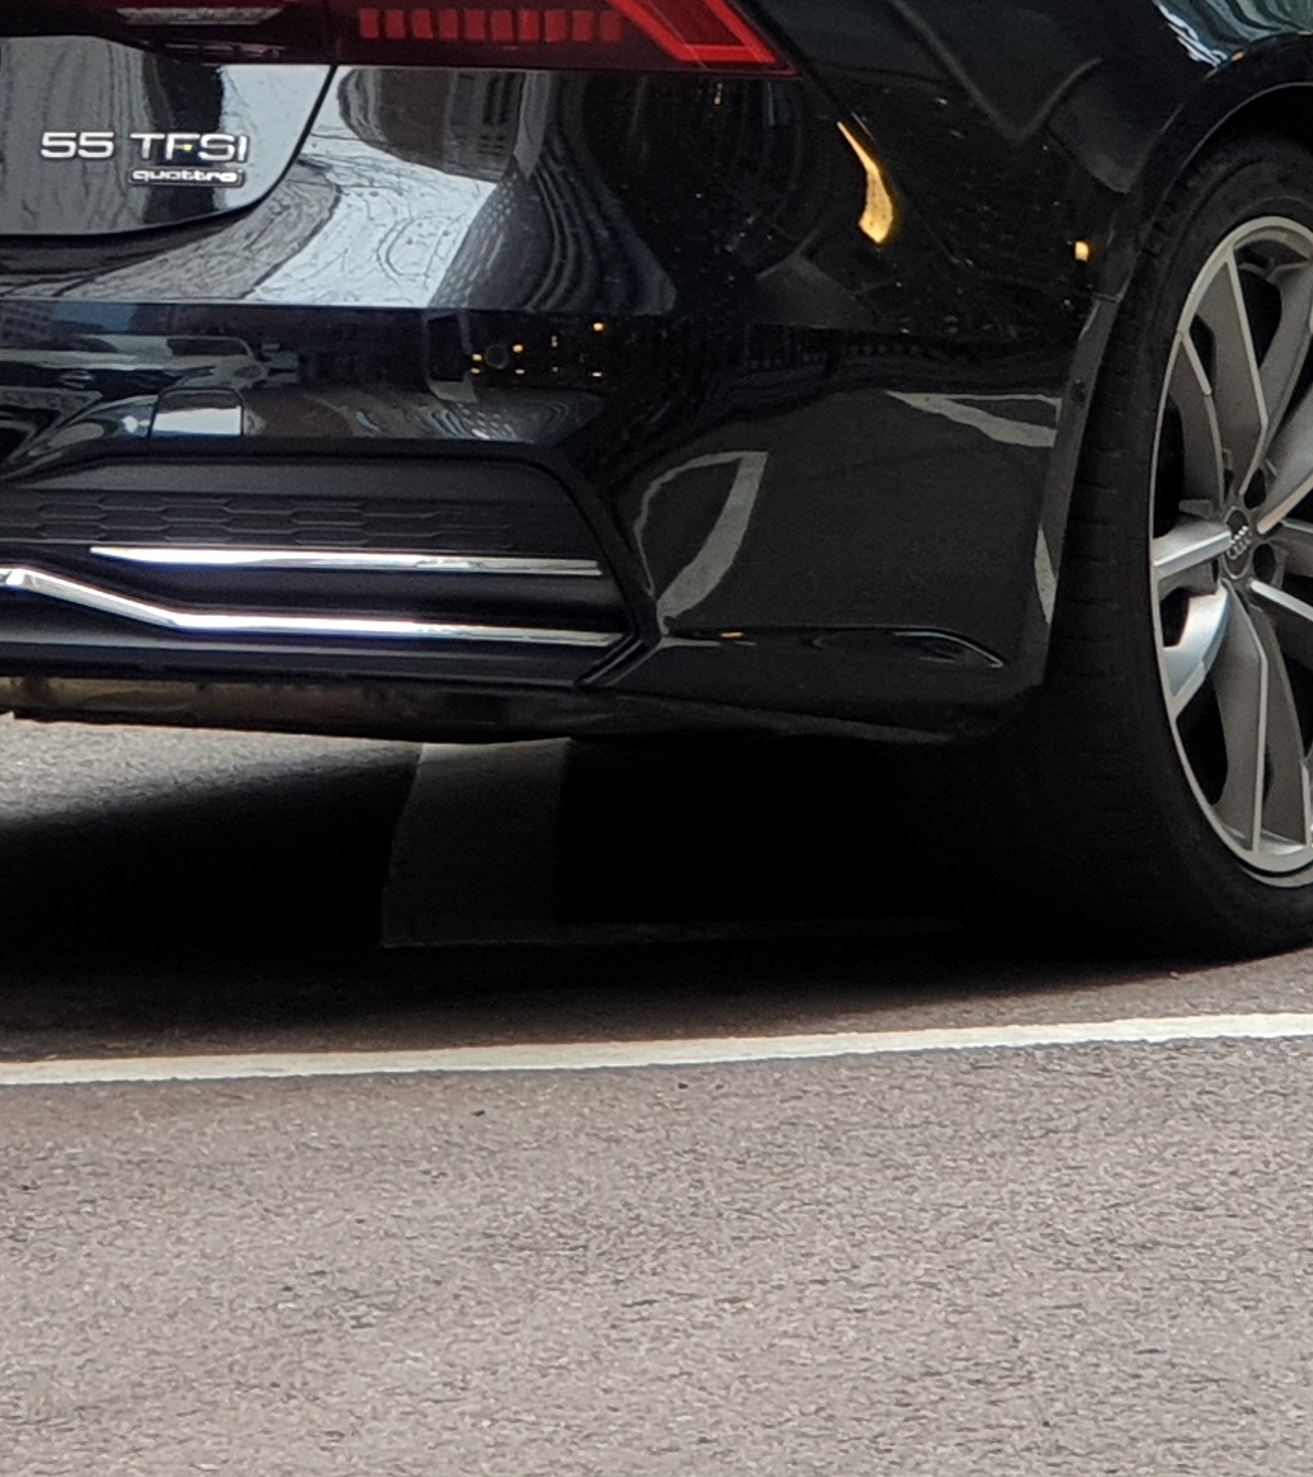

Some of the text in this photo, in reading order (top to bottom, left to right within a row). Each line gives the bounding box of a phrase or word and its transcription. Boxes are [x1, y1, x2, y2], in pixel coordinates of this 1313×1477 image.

[40, 131, 249, 162] 55 TFSI
[132, 169, 239, 183] quattro
